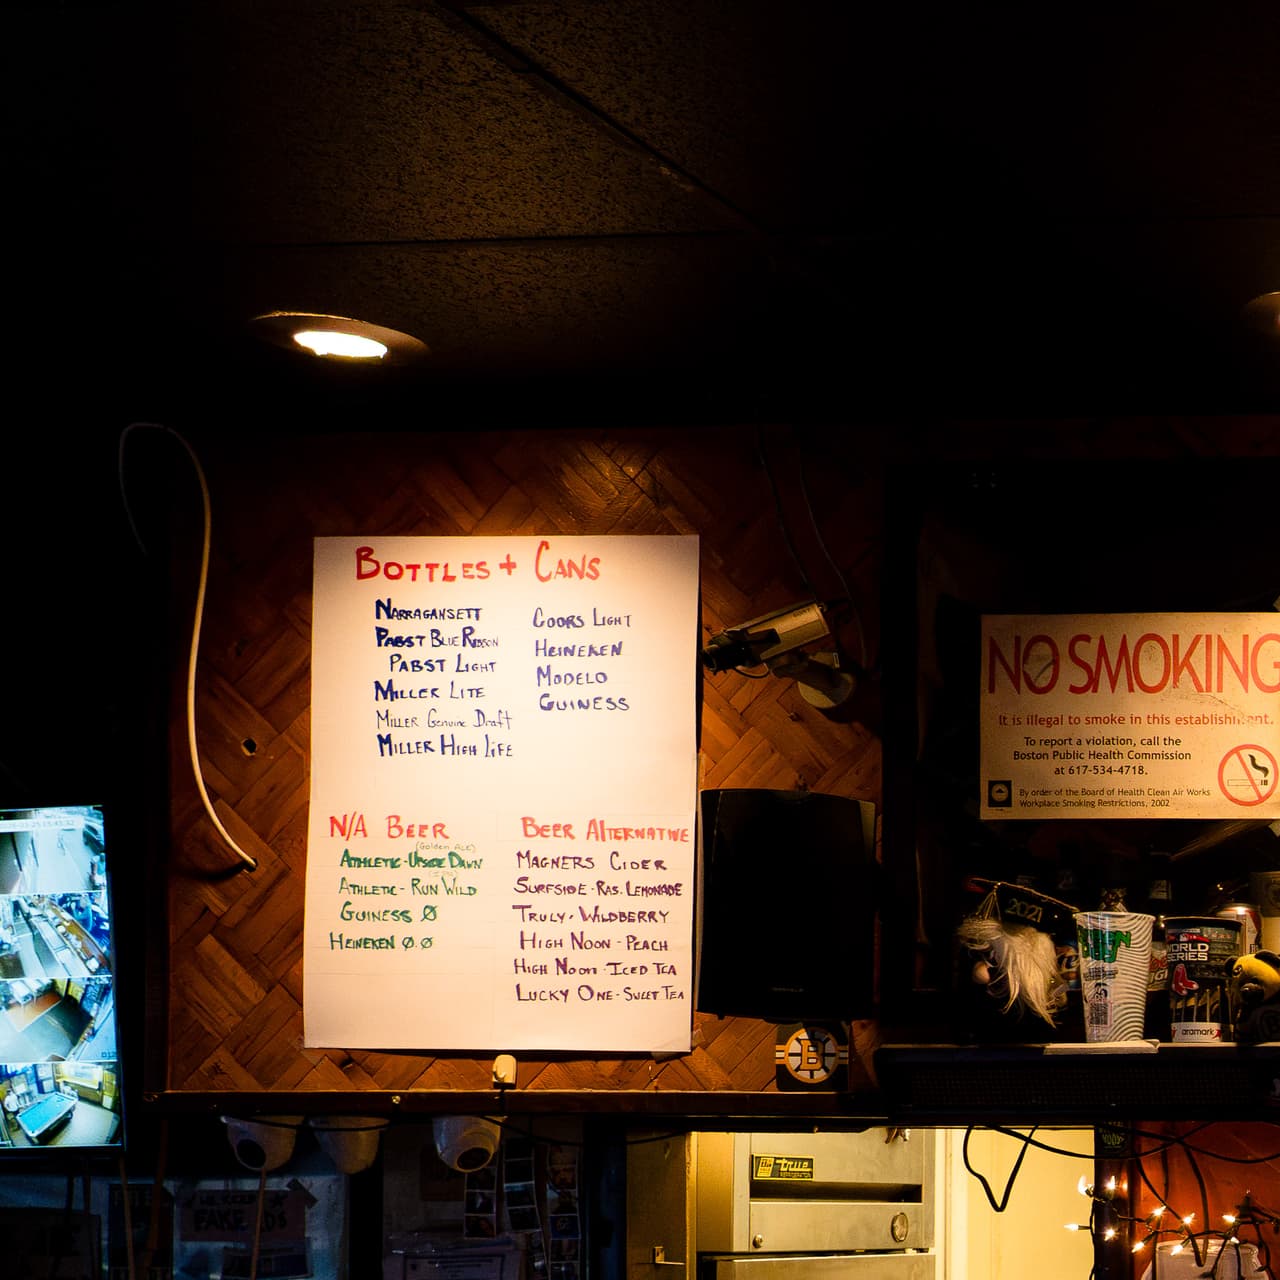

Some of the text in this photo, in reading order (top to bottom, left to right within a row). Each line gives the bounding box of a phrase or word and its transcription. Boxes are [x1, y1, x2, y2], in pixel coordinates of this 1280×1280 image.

[356, 540, 600, 582] BOTTLES CANS
[593, 608, 632, 627] LIGHT
[390, 654, 496, 673] PABST LIGHT
[988, 633, 1060, 694] NO
[537, 666, 607, 687] MODELO
[450, 681, 485, 699] LITE
[539, 693, 630, 712] GUINESS
[1012, 713, 1170, 728] is illegal to smoke in this
[377, 734, 435, 756] MILLER
[1024, 736, 1181, 748] To report violation, call the
[1013, 750, 1191, 761] Boston Public Health Commission
[1054, 765, 1148, 775] at 617-534-4718.
[330, 814, 449, 839] N/A BEER
[522, 817, 576, 840] BEER
[517, 851, 668, 871] MAGNERS CIDER
[412, 877, 477, 897] RUN WILD
[340, 902, 412, 922] GUINESS
[580, 906, 670, 923] WILDBERRY
[330, 932, 395, 949] HEINEKEN
[520, 931, 668, 952] HIGH PEACH
[1167, 952, 1208, 961] SERIES
[514, 959, 548, 976] HIGH
[516, 983, 613, 1003] LUCKY ONE
